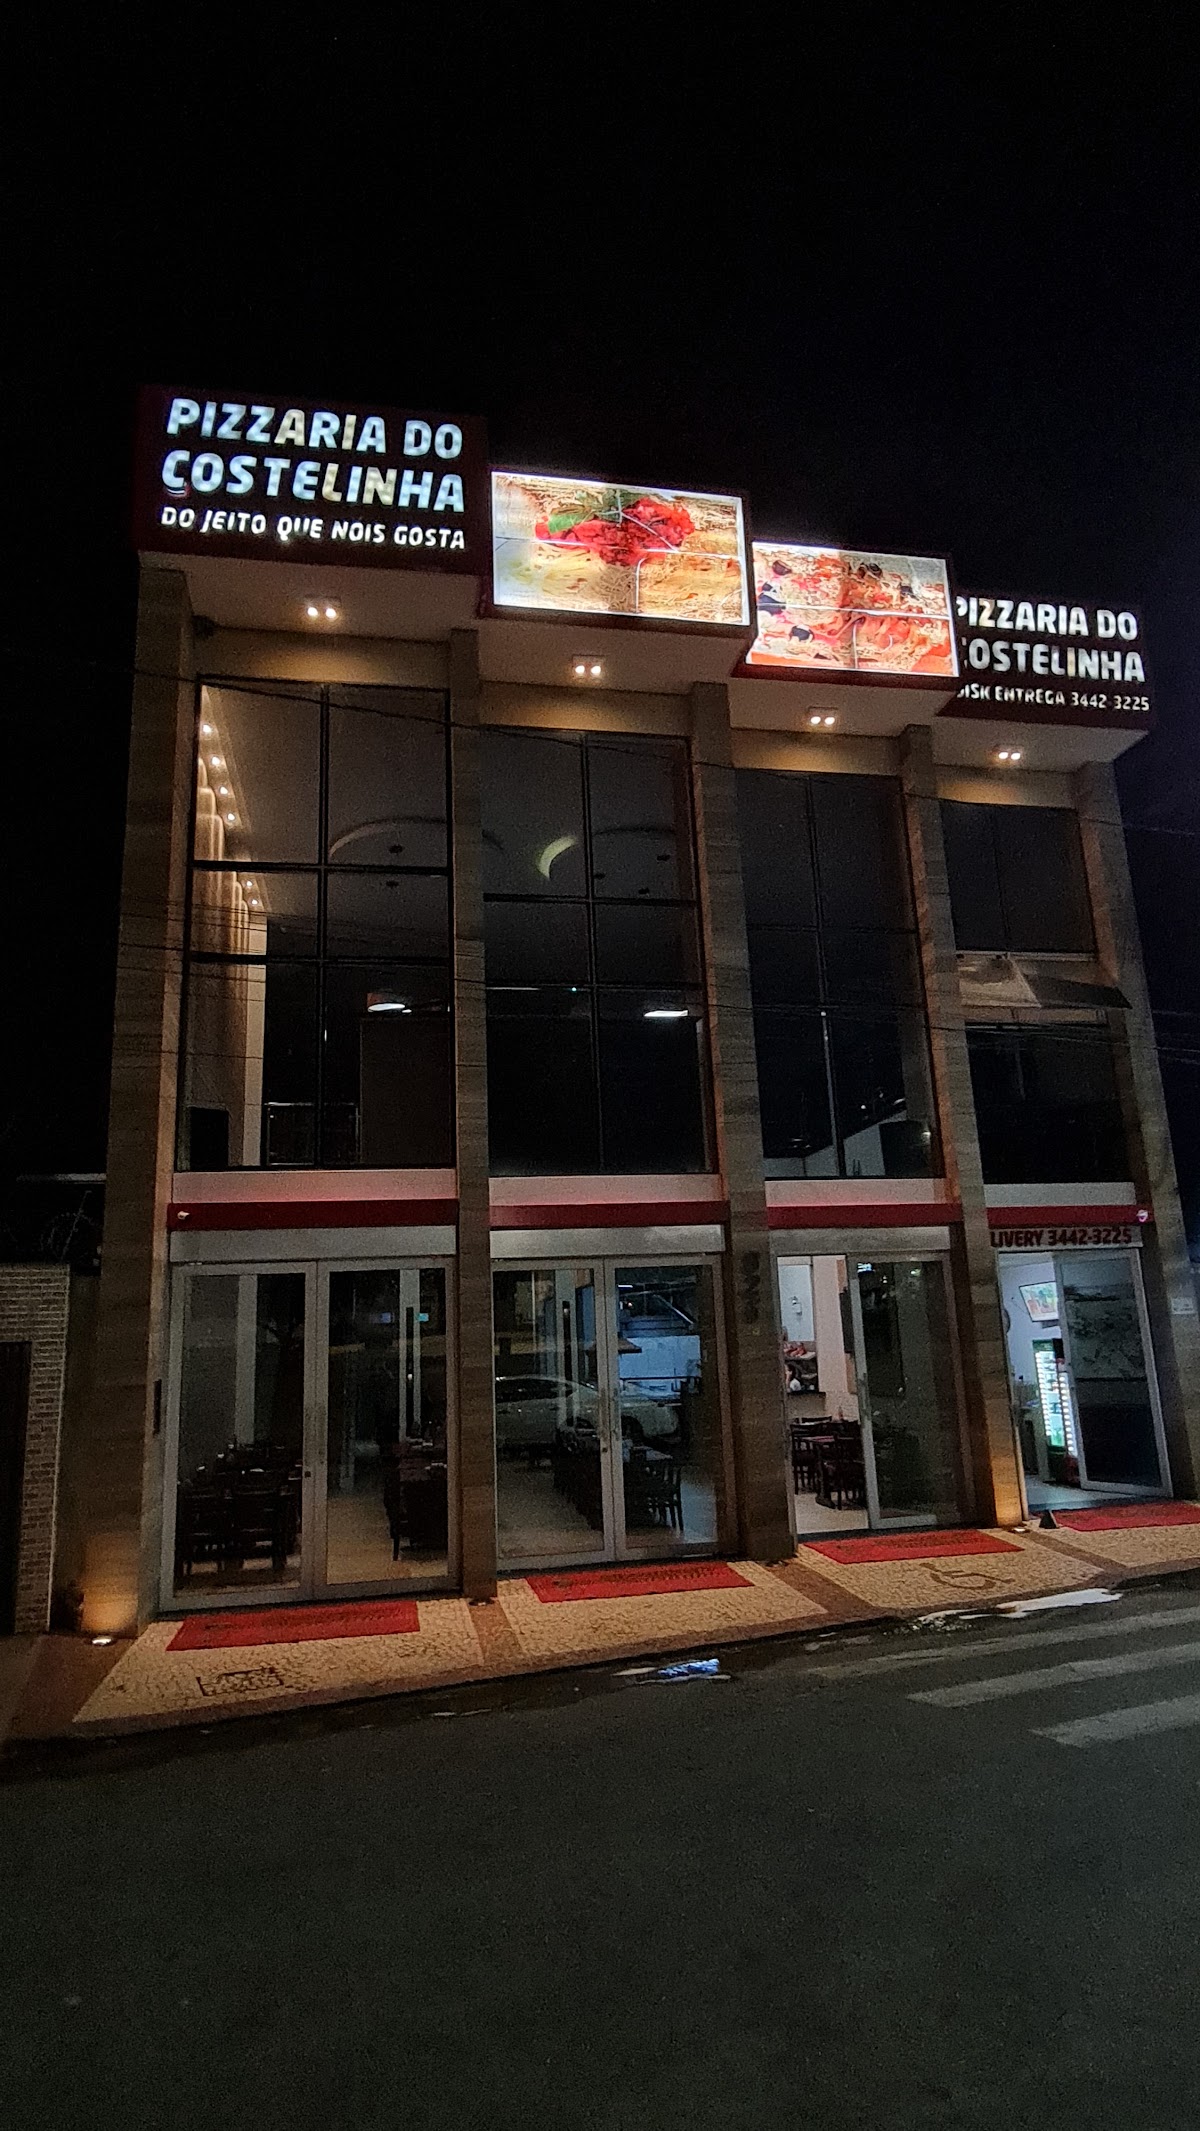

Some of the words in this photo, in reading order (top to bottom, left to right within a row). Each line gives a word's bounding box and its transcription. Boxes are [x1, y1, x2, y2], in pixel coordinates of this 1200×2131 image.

[166, 398, 387, 454] PIZZARIA
[403, 419, 463, 460] DO
[161, 449, 465, 513] COSTELINHA
[161, 506, 196, 528] DO
[200, 509, 267, 534] JEITO
[276, 516, 323, 541] QUE
[331, 520, 386, 544] NOIS
[394, 525, 466, 550] GOSTA
[1096, 609, 1139, 641] DO
[961, 637, 1146, 682] OSTELINHA
[994, 685, 1065, 705] ENTREGA
[1071, 691, 1107, 709] 3442
[1113, 694, 1150, 711] 3225
